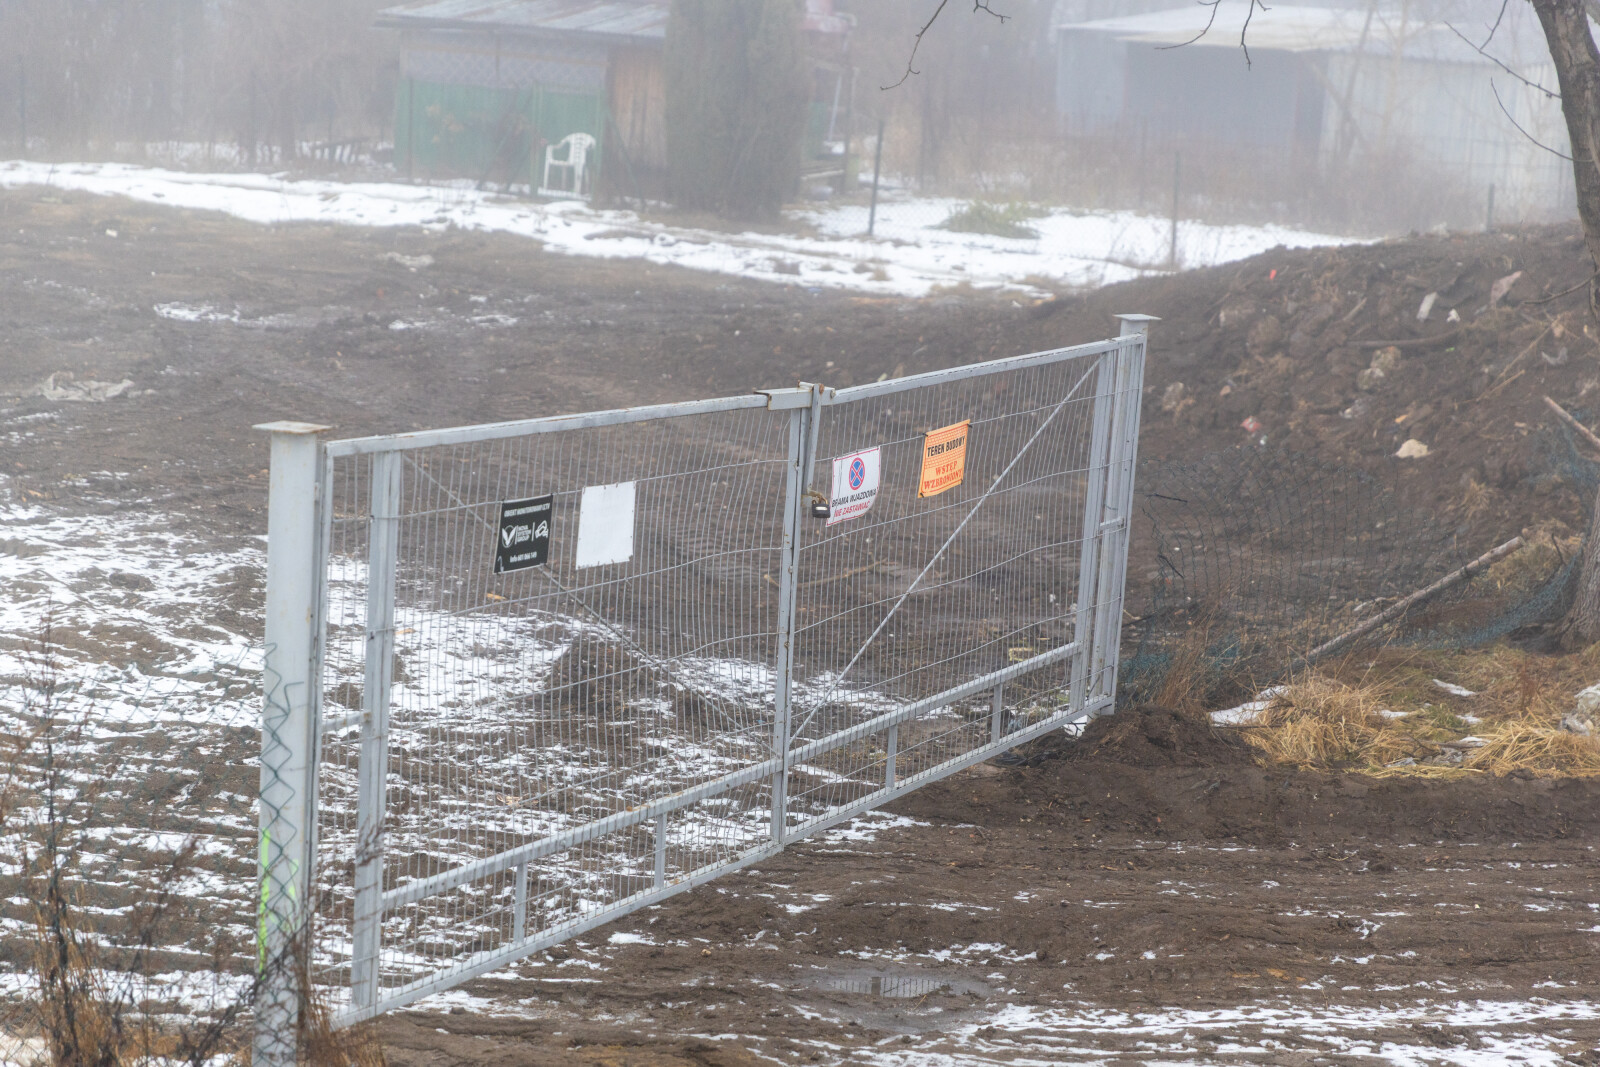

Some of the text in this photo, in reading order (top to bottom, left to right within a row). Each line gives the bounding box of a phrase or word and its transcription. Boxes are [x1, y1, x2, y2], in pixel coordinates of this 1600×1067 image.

[928, 435, 965, 457] TEREN BUDOWY
[924, 469, 962, 490] WZBRONIONY
[831, 488, 877, 507] BRAMA WJAZDOWA
[834, 508, 842, 517] NIE
